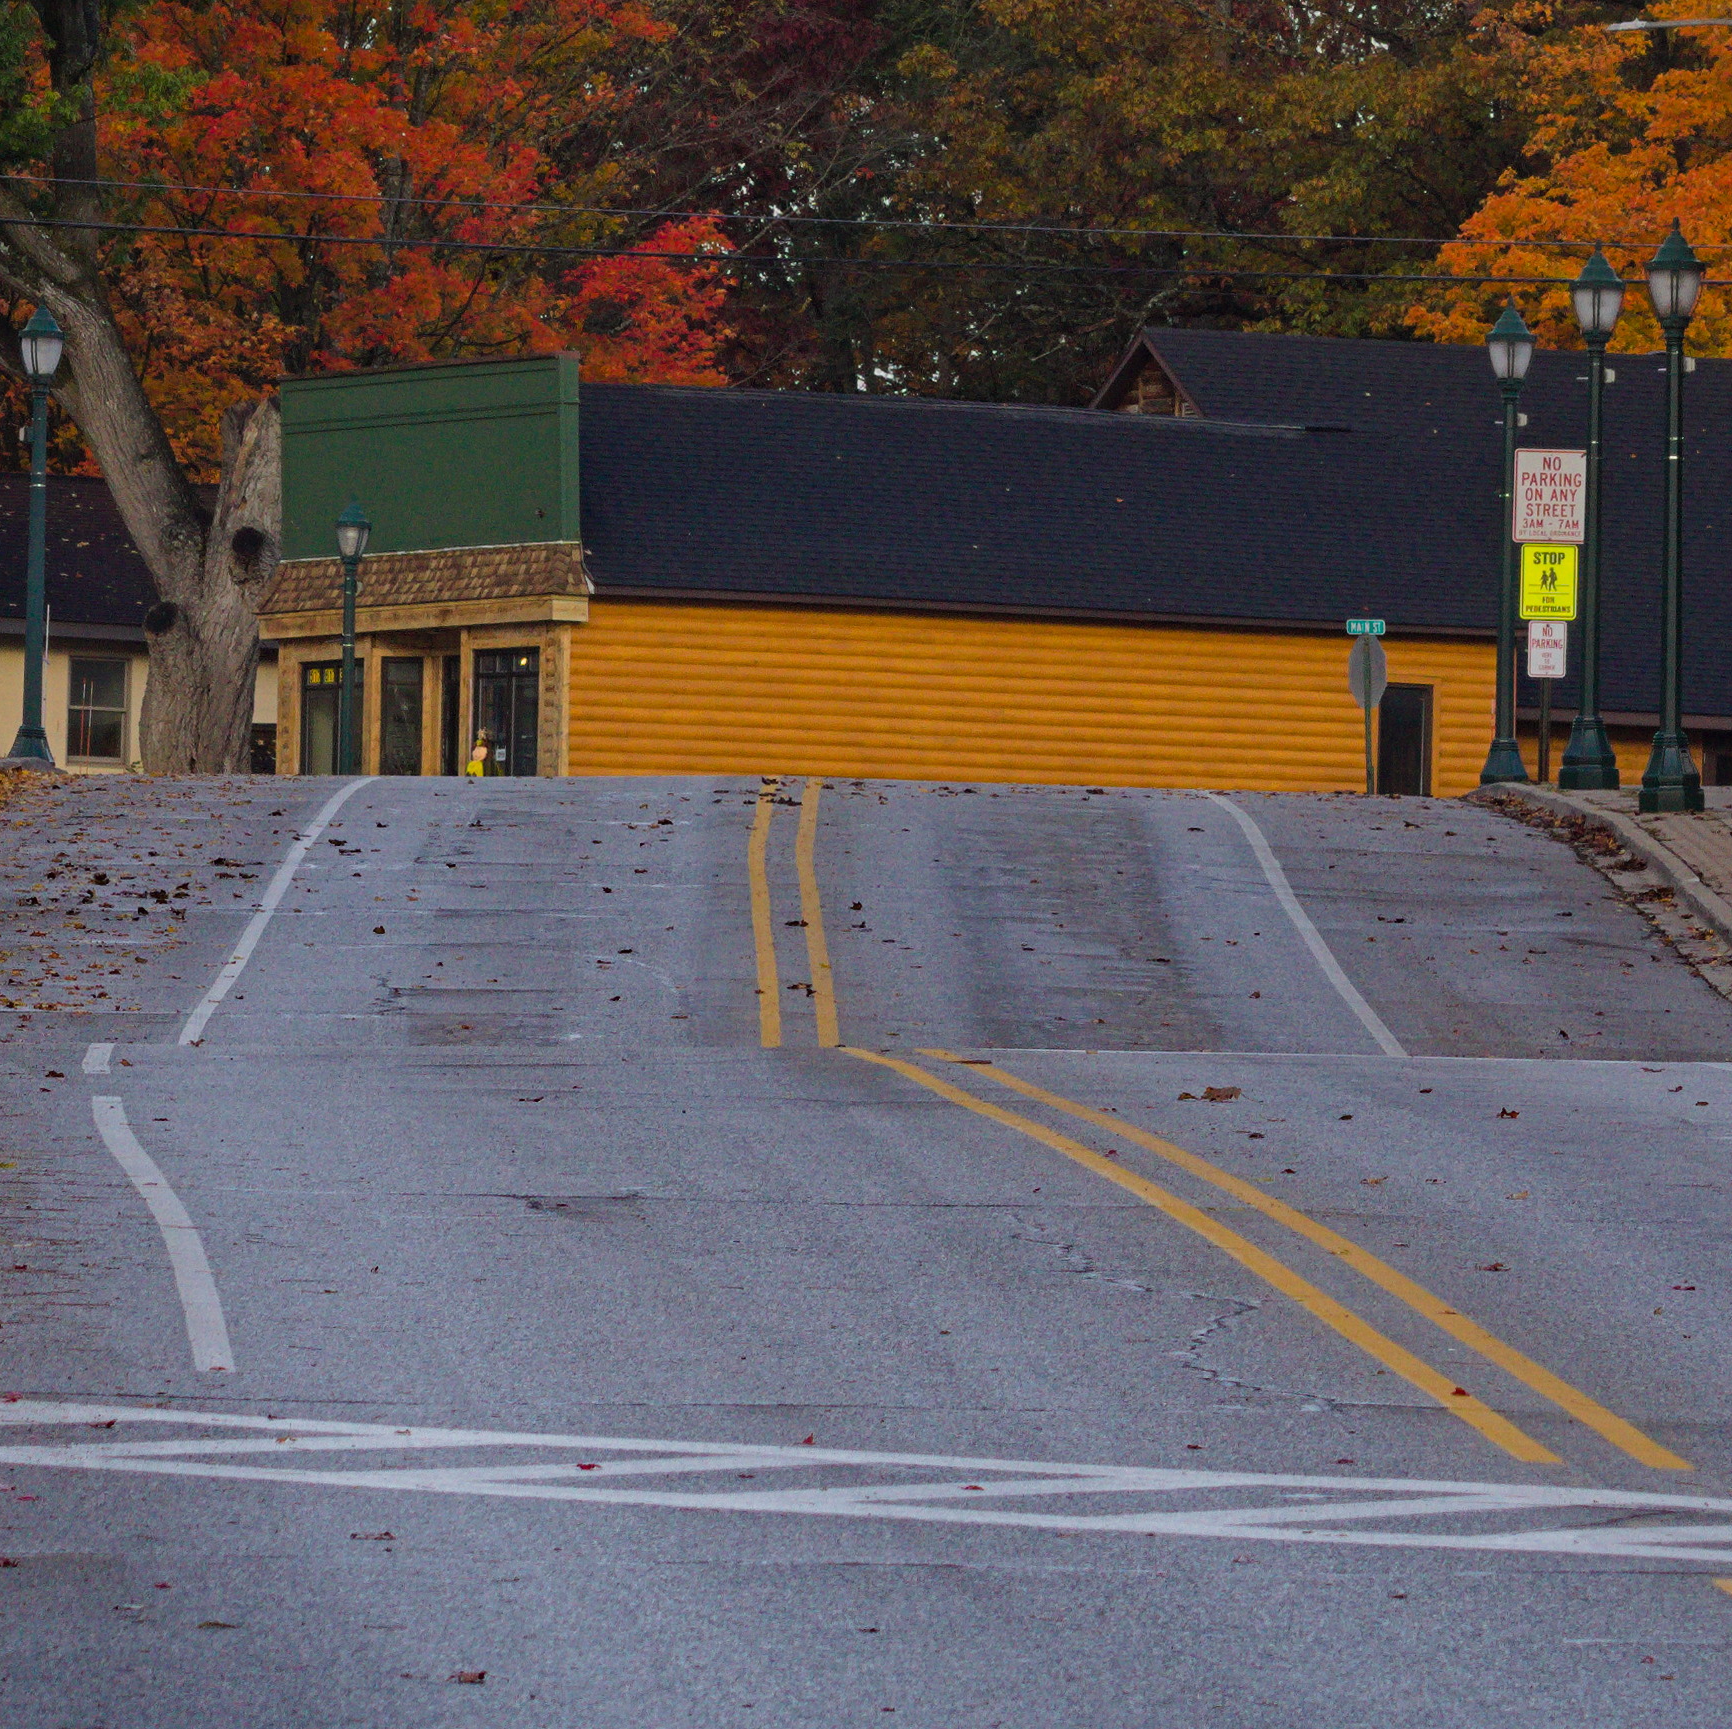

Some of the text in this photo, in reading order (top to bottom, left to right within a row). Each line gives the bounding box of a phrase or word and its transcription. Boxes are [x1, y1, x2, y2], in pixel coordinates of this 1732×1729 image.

[1542, 456, 1562, 471] NO
[1521, 472, 1582, 488] PARKING
[1525, 487, 1578, 502] ON ANY
[1525, 502, 1576, 518] STREET
[1522, 518, 1544, 529] 3AM
[1558, 519, 1580, 530] 7AM
[1533, 551, 1565, 565] STOP
[1542, 596, 1555, 604] FOR
[1525, 605, 1571, 613] PEDESTRIANS
[1350, 622, 1381, 633] MAIN ST
[1542, 627, 1553, 637] NO
[1532, 638, 1563, 649] PARKING
